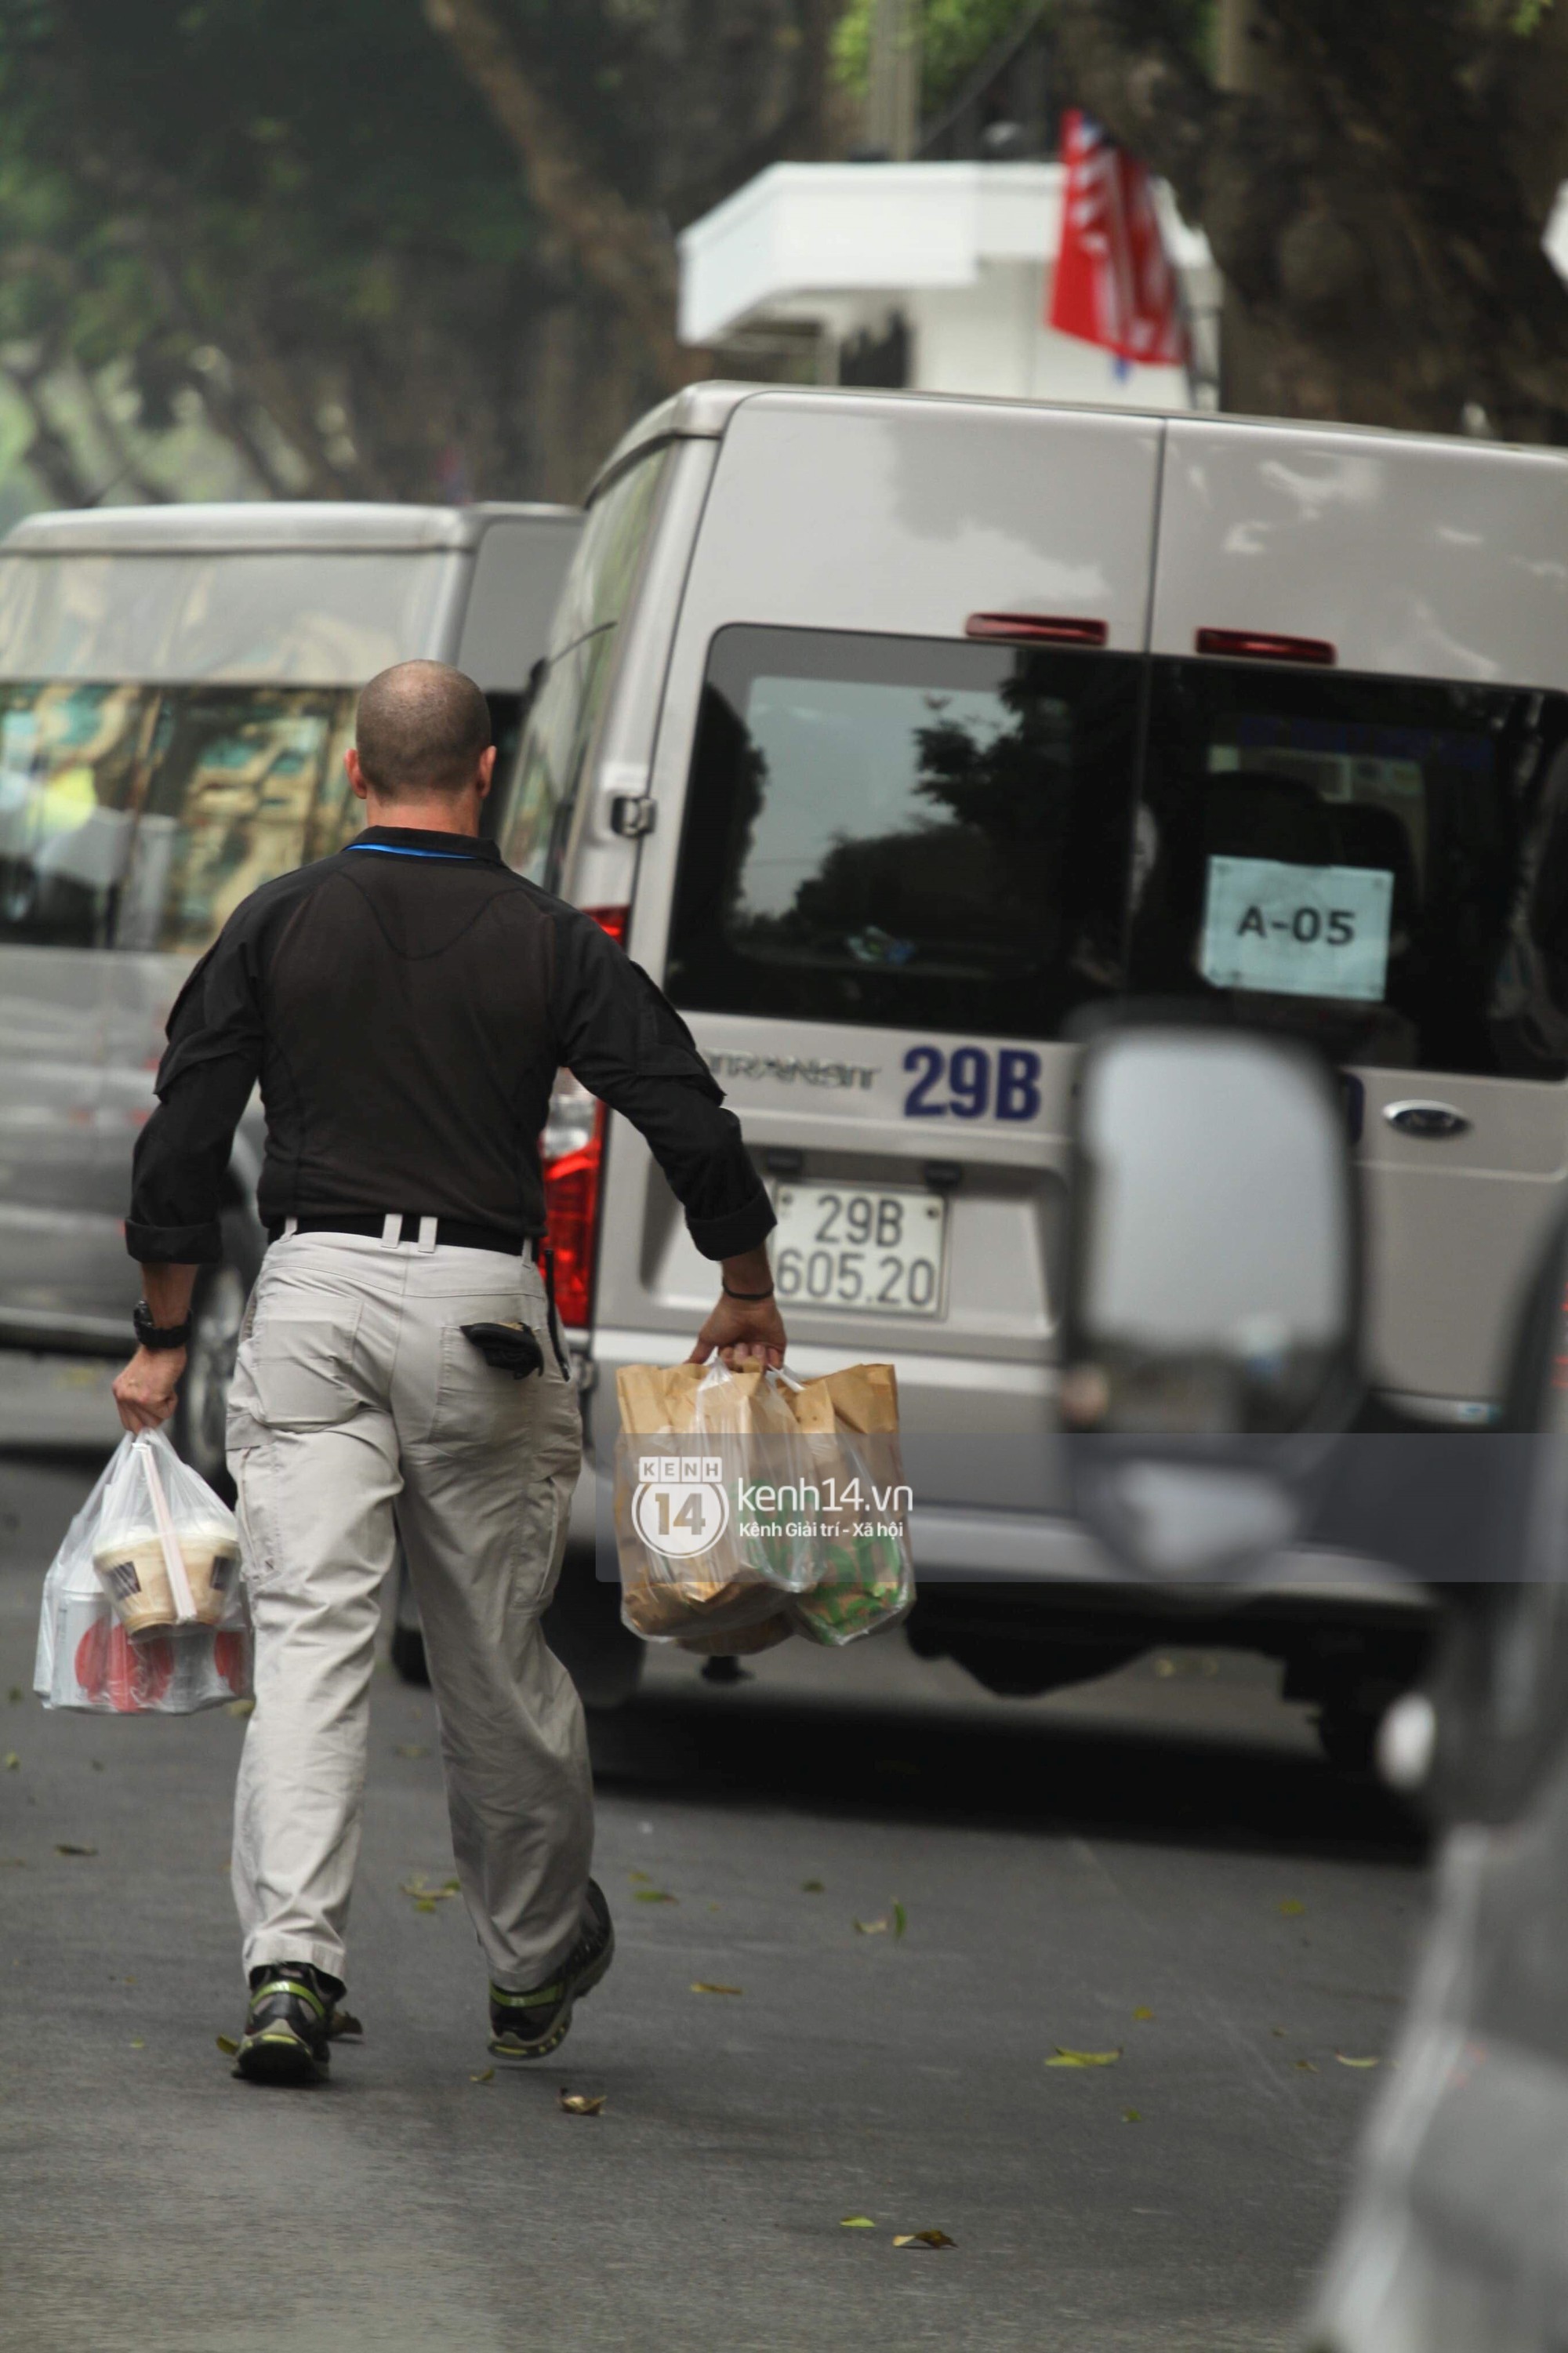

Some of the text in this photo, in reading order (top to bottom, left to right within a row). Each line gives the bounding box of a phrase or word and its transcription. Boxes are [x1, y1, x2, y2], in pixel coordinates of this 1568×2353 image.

[1237, 906, 1356, 946] A-05
[902, 1046, 1042, 1121] 29B
[815, 1194, 904, 1248] 29B
[776, 1248, 935, 1308] 605.20
